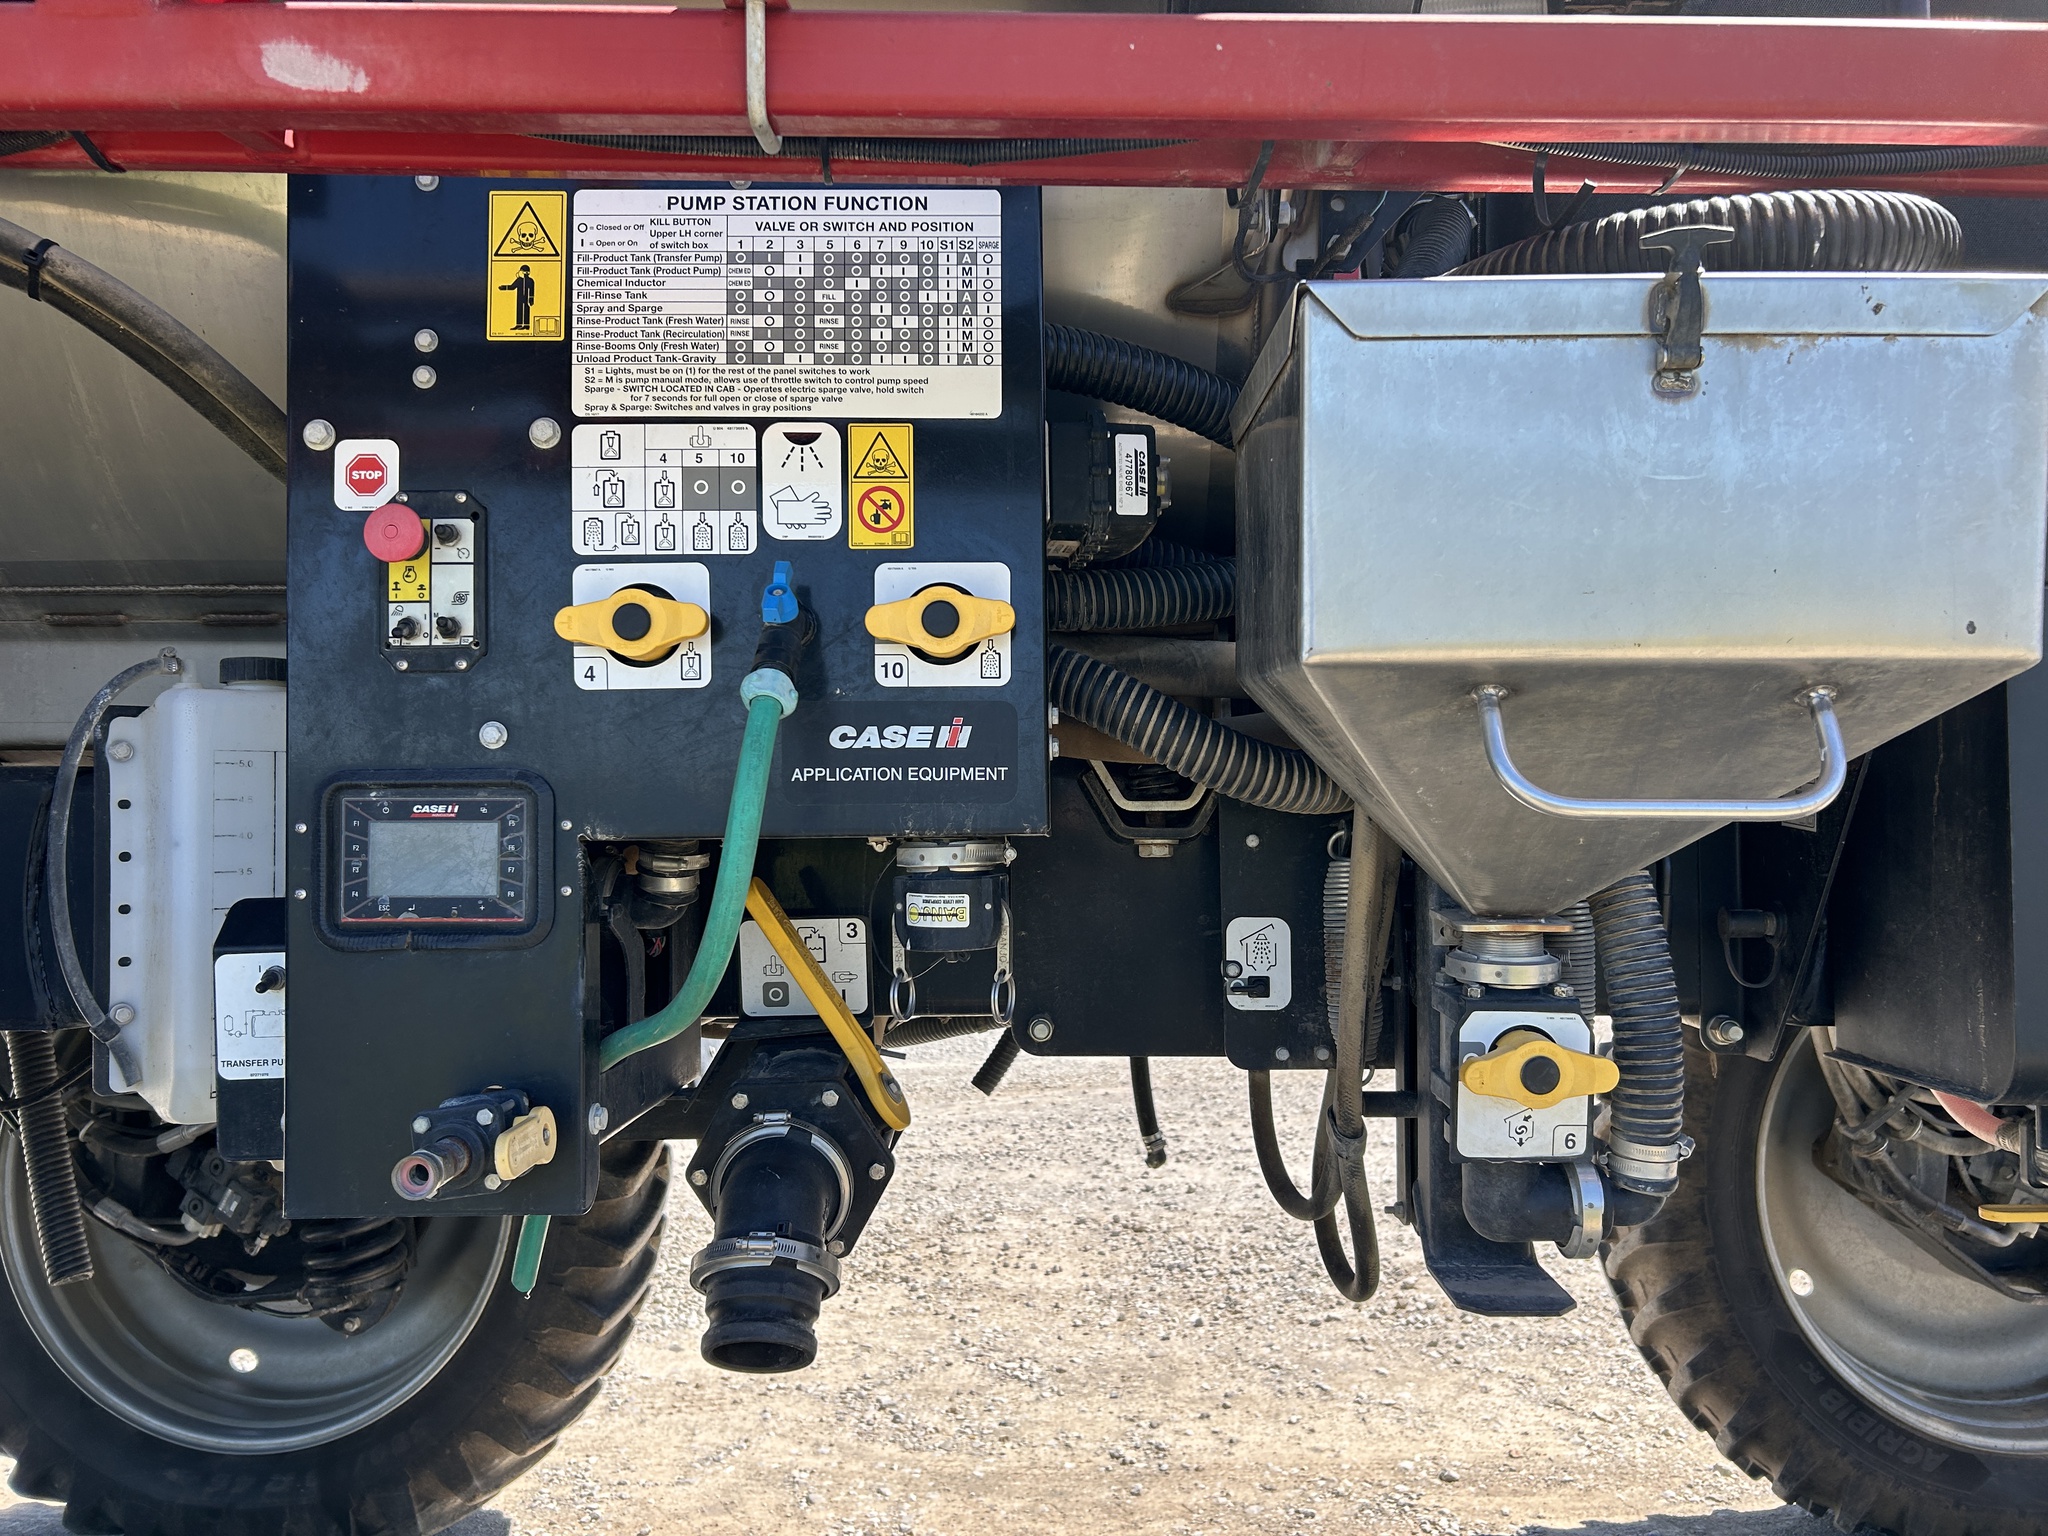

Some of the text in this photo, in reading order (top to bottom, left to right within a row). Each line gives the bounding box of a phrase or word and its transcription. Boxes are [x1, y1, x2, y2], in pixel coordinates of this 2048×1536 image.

[667, 196, 928, 211] PUMP STATION FUNCTION
[650, 218, 711, 226] KILL BUTTON
[755, 221, 973, 232] VALVE OR SWITCH AND POSITION
[650, 229, 677, 239] Upper
[679, 229, 691, 237] LH
[595, 239, 616, 247] Open
[649, 241, 708, 249] of switch box
[738, 239, 999, 250] 1 2 3 5 6 7 9 10 S1 S2 SPARGE
[577, 254, 722, 263] Fill-Product Tank (Transfer Pump)
[577, 266, 721, 276] Fill-Product Tank (Product Pump)
[577, 279, 666, 287] Chemical Inductor
[577, 291, 648, 299] Fill-Rinse Tank
[576, 304, 663, 314] Spray and Sparge
[576, 316, 724, 327] Rinse-Product Tank (Fresh Water)
[576, 330, 724, 339] Rinse-Product Tank (Recirculation)
[576, 342, 719, 352] Rinse-Booms Only (Fresh Water)
[576, 354, 716, 363] Unload Product Tank-Gravity
[584, 366, 594, 374] S1
[605, 366, 634, 376] Lights,
[685, 367, 696, 376] (1)
[698, 367, 710, 375] for
[712, 367, 726, 375] the
[728, 367, 745, 375] rest
[746, 367, 755, 375] of
[757, 367, 771, 375] the
[773, 367, 796, 376] panel
[799, 367, 836, 375] switches
[838, 367, 847, 375] to
[849, 367, 870, 375] work
[584, 376, 596, 384] S2
[605, 376, 613, 384] M
[615, 376, 623, 384] is
[651, 376, 683, 384] manual
[684, 376, 711, 386] mode,
[713, 376, 741, 384] allows
[834, 377, 843, 385] to
[845, 377, 875, 385] control
[903, 377, 929, 386] speed
[584, 385, 615, 394] Sparge
[623, 385, 658, 393] SWITCH
[660, 385, 702, 393] LOCATED
[705, 385, 714, 393] IN
[716, 385, 735, 393] CAB
[743, 385, 782, 395] Operates
[818, 387, 847, 395] sparge
[849, 386, 874, 395] valve,
[876, 386, 894, 394] hold
[895, 386, 924, 394] switch
[630, 394, 642, 402] for
[704, 395, 717, 403] full
[719, 396, 741, 404] open
[754, 395, 777, 403] close
[779, 395, 788, 403] of
[821, 395, 843, 403] valve
[584, 404, 609, 413] Spray
[619, 404, 652, 413] Sparge:
[654, 404, 693, 412] Switches
[695, 404, 711, 412] and
[713, 404, 740, 412] valves
[742, 404, 750, 412] in
[773, 404, 812, 413] positions
[659, 453, 745, 464] 4 5 10
[352, 470, 382, 480] STOP
[1125, 453, 1133, 497] 47780967
[584, 666, 596, 682] 4
[881, 662, 903, 678] 10
[828, 725, 934, 749] CASE
[791, 767, 1008, 782] APPLICATION EQUIPMENT
[412, 804, 447, 814] CASE
[351, 843, 361, 852] F2
[506, 866, 516, 874] F7
[350, 890, 360, 898] F4
[506, 890, 516, 898] F8
[378, 904, 391, 912] ESC
[846, 922, 858, 938] 3
[220, 1059, 269, 1068] TRANSFER
[1565, 1133, 1576, 1149] 6
[1798, 1361, 1950, 1472] AGRIBIB RC
